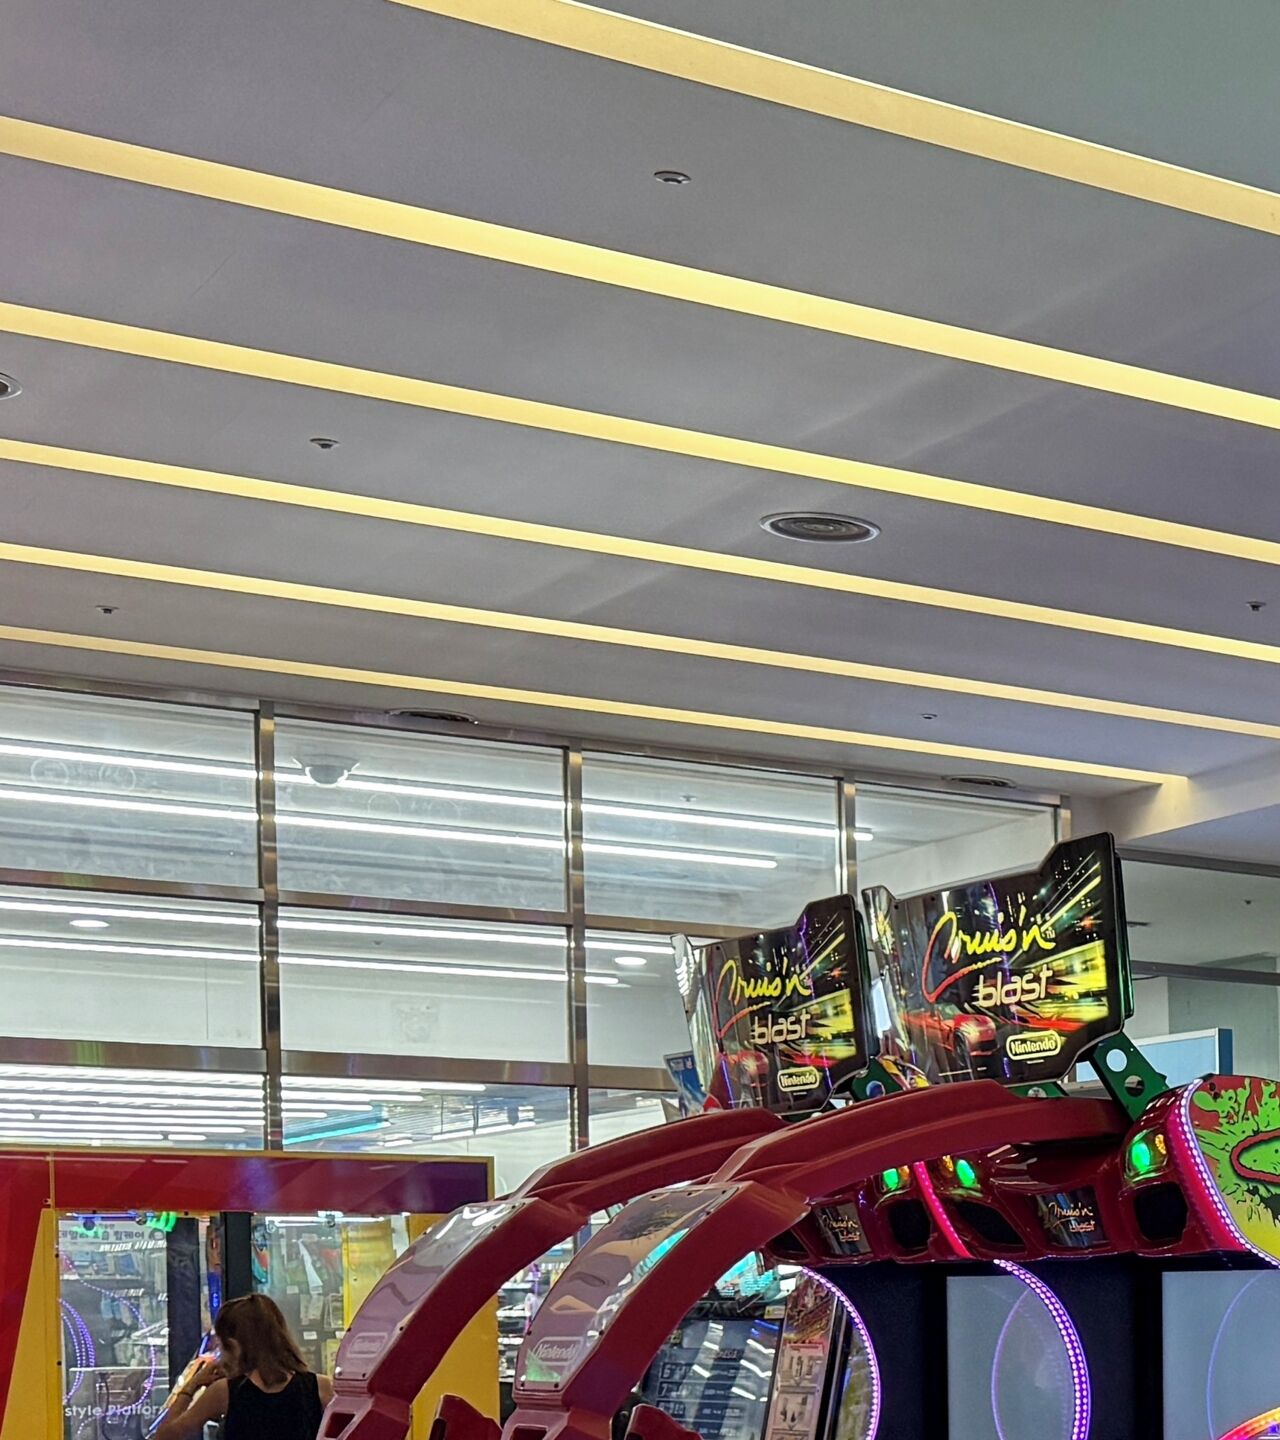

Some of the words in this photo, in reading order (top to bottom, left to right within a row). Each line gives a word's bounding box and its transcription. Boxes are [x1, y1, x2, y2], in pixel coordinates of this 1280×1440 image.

[922, 905, 1056, 1004] Cruis'n
[710, 957, 811, 1039] Cruis'n
[978, 964, 1053, 1007] blast
[753, 1009, 811, 1044] blast
[1010, 1036, 1056, 1054] Nintendo
[779, 1072, 816, 1087] Nintendo
